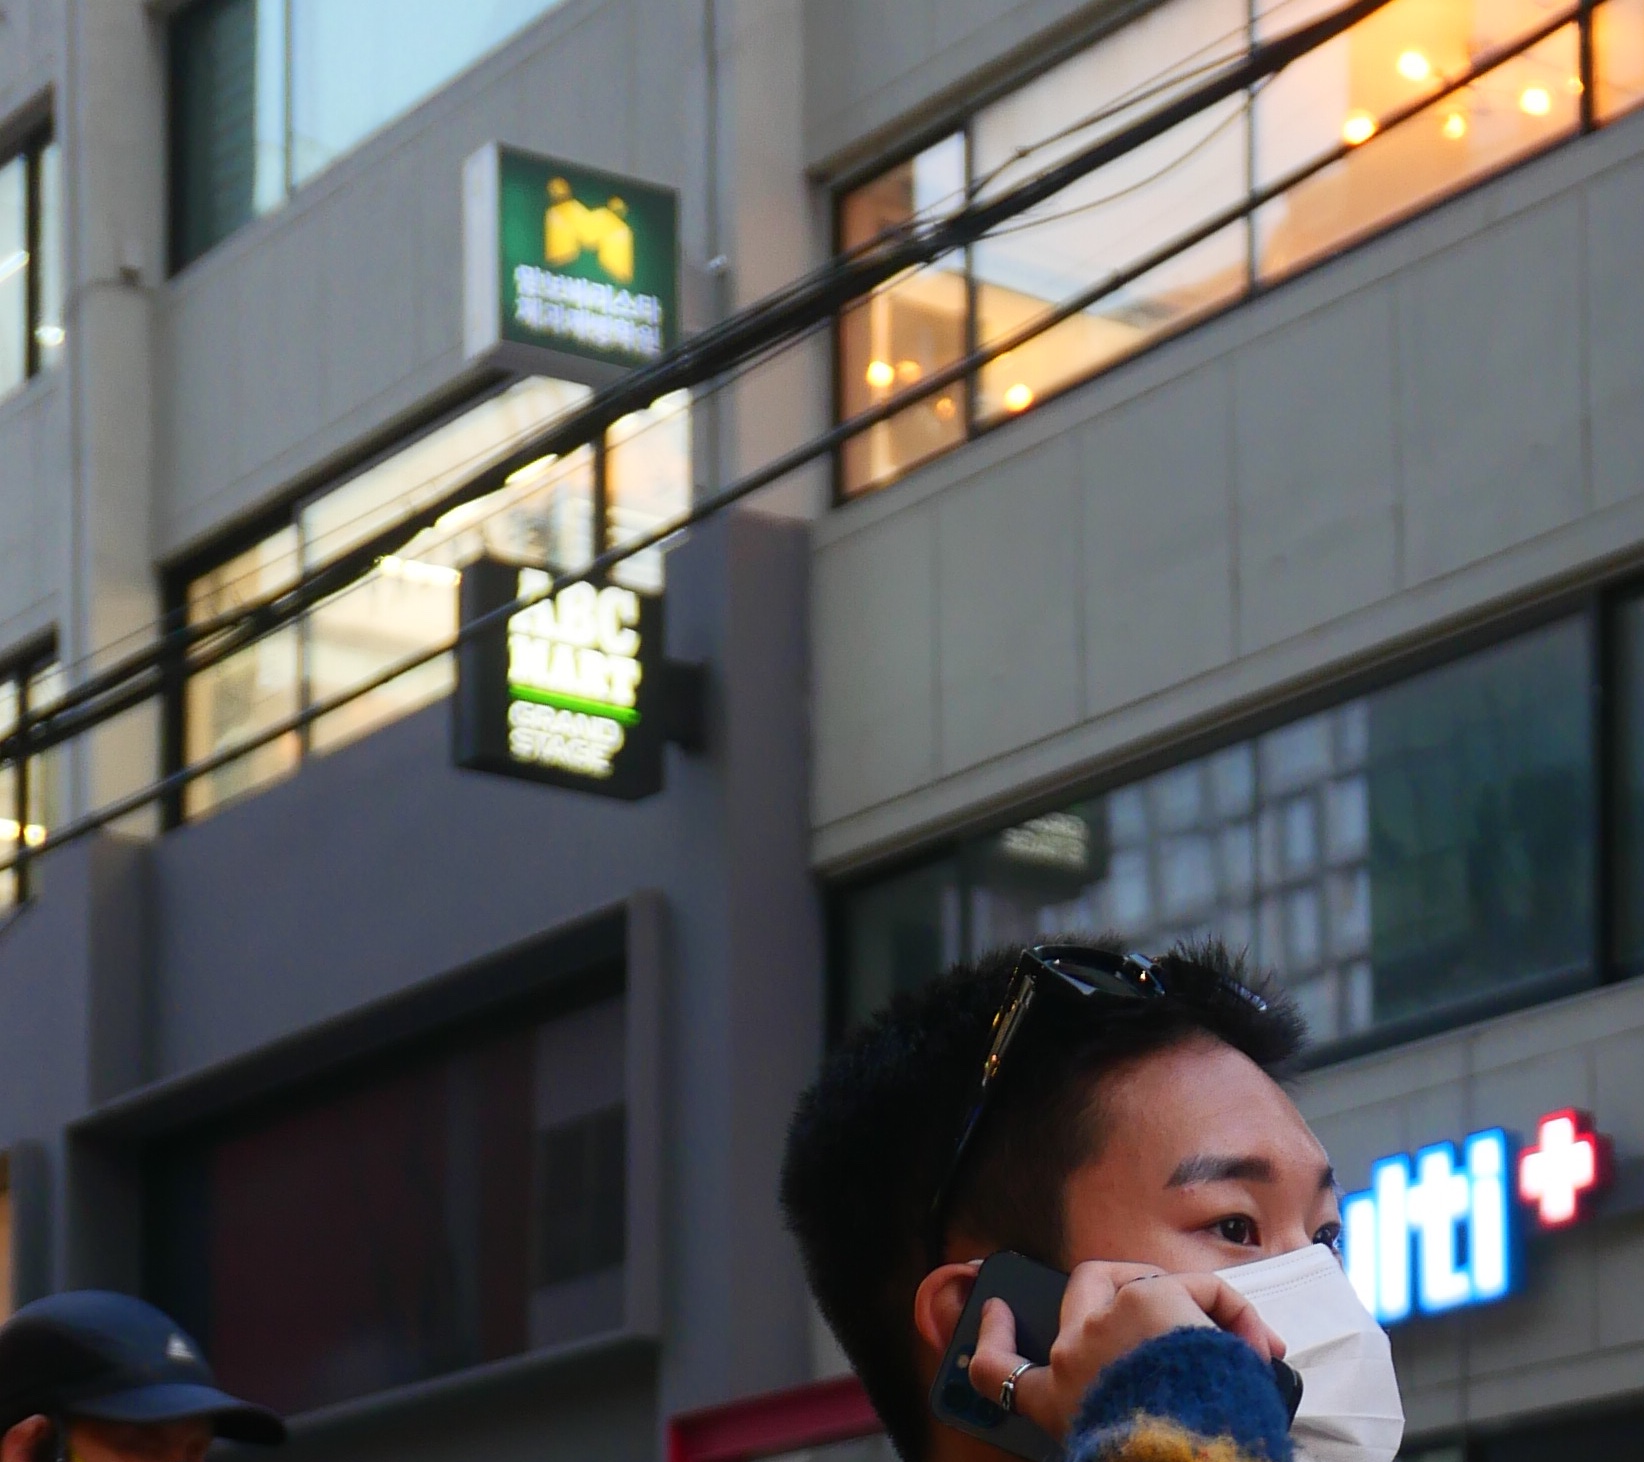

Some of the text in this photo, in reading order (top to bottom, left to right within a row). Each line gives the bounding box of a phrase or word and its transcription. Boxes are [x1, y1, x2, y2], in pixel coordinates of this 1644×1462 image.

[508, 567, 641, 660] ABC
[508, 633, 643, 707] MART
[508, 700, 625, 753] GRAND
[509, 727, 615, 778] STAGE
